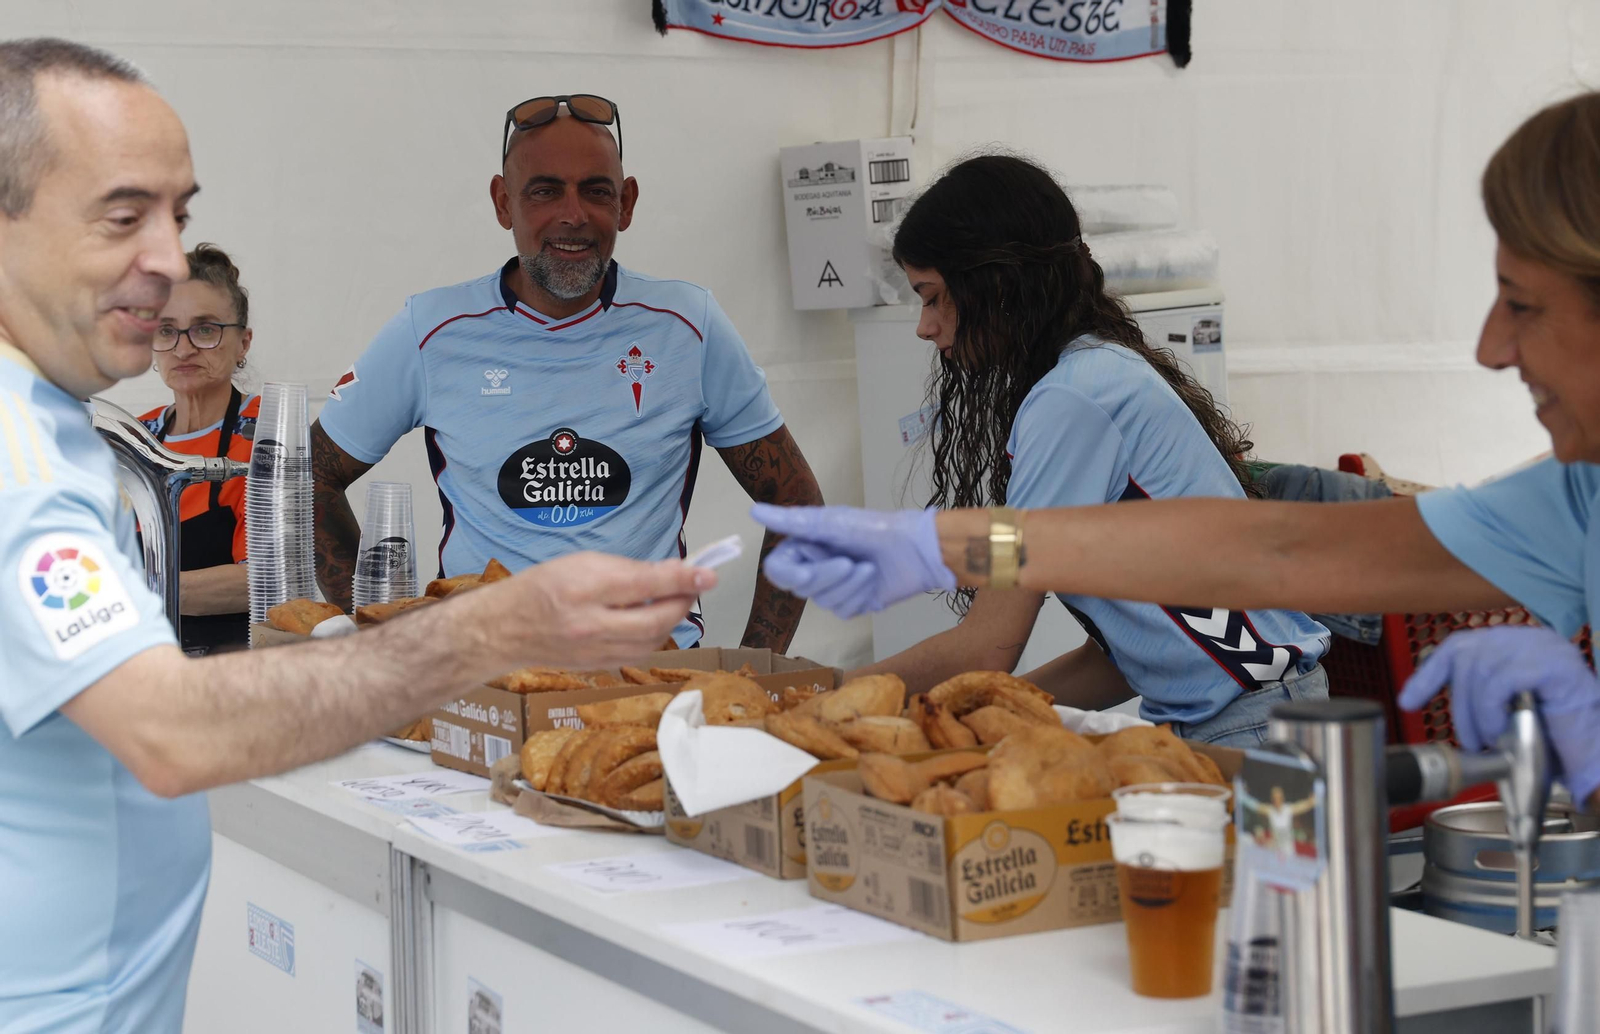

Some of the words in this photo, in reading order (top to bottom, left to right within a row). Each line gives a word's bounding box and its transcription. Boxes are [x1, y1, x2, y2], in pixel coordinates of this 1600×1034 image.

[1011, 29, 1046, 49] PARA
[794, 191, 821, 201] BODEGAS
[481, 386, 511, 395] hummel
[520, 457, 611, 480] Estrella
[523, 480, 605, 503] Galicia
[551, 503, 578, 524] 0,0
[56, 602, 125, 643] LaLiga
[459, 699, 488, 724] Galicia
[962, 846, 1038, 882] Estrella
[966, 869, 1037, 904] Galicia
